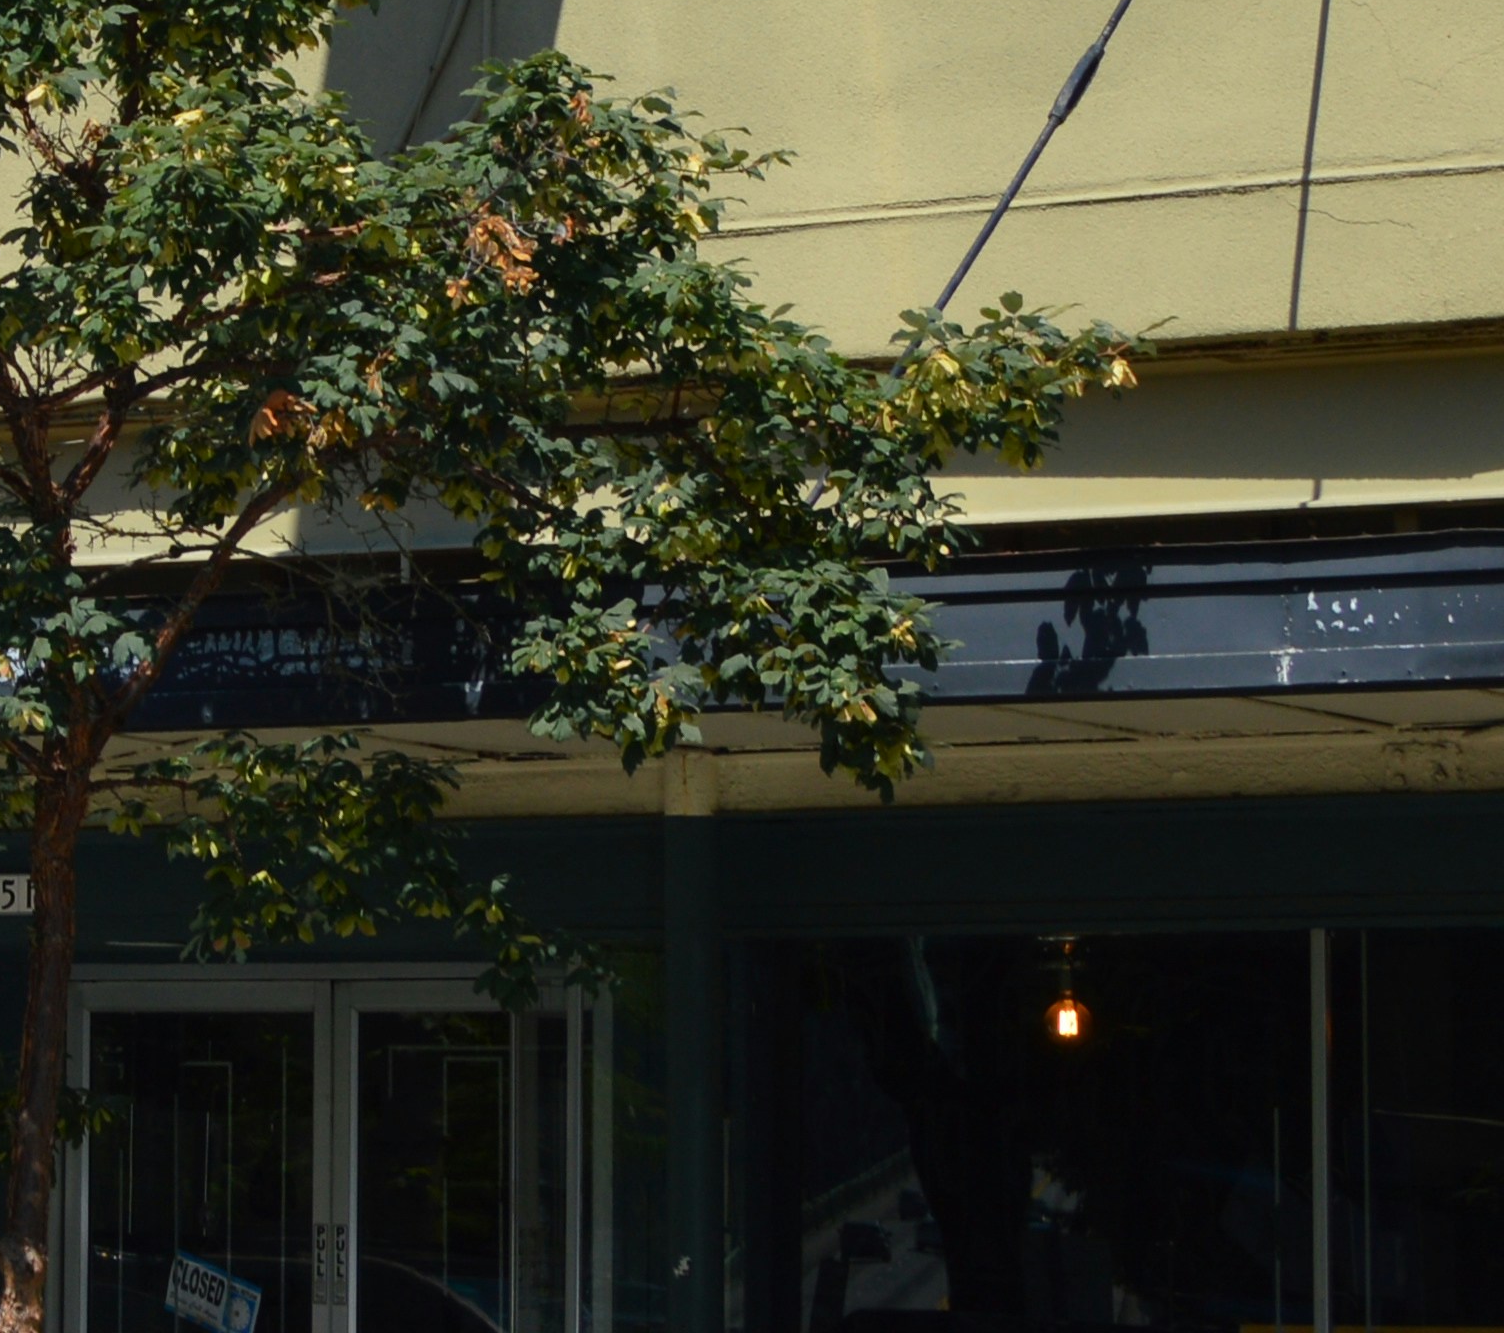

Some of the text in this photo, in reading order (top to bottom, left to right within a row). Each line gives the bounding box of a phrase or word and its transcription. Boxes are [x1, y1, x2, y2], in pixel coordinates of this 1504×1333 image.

[316, 1225, 326, 1277] PULL
[336, 1226, 345, 1278] PULL
[172, 1259, 226, 1307] CLOSED
